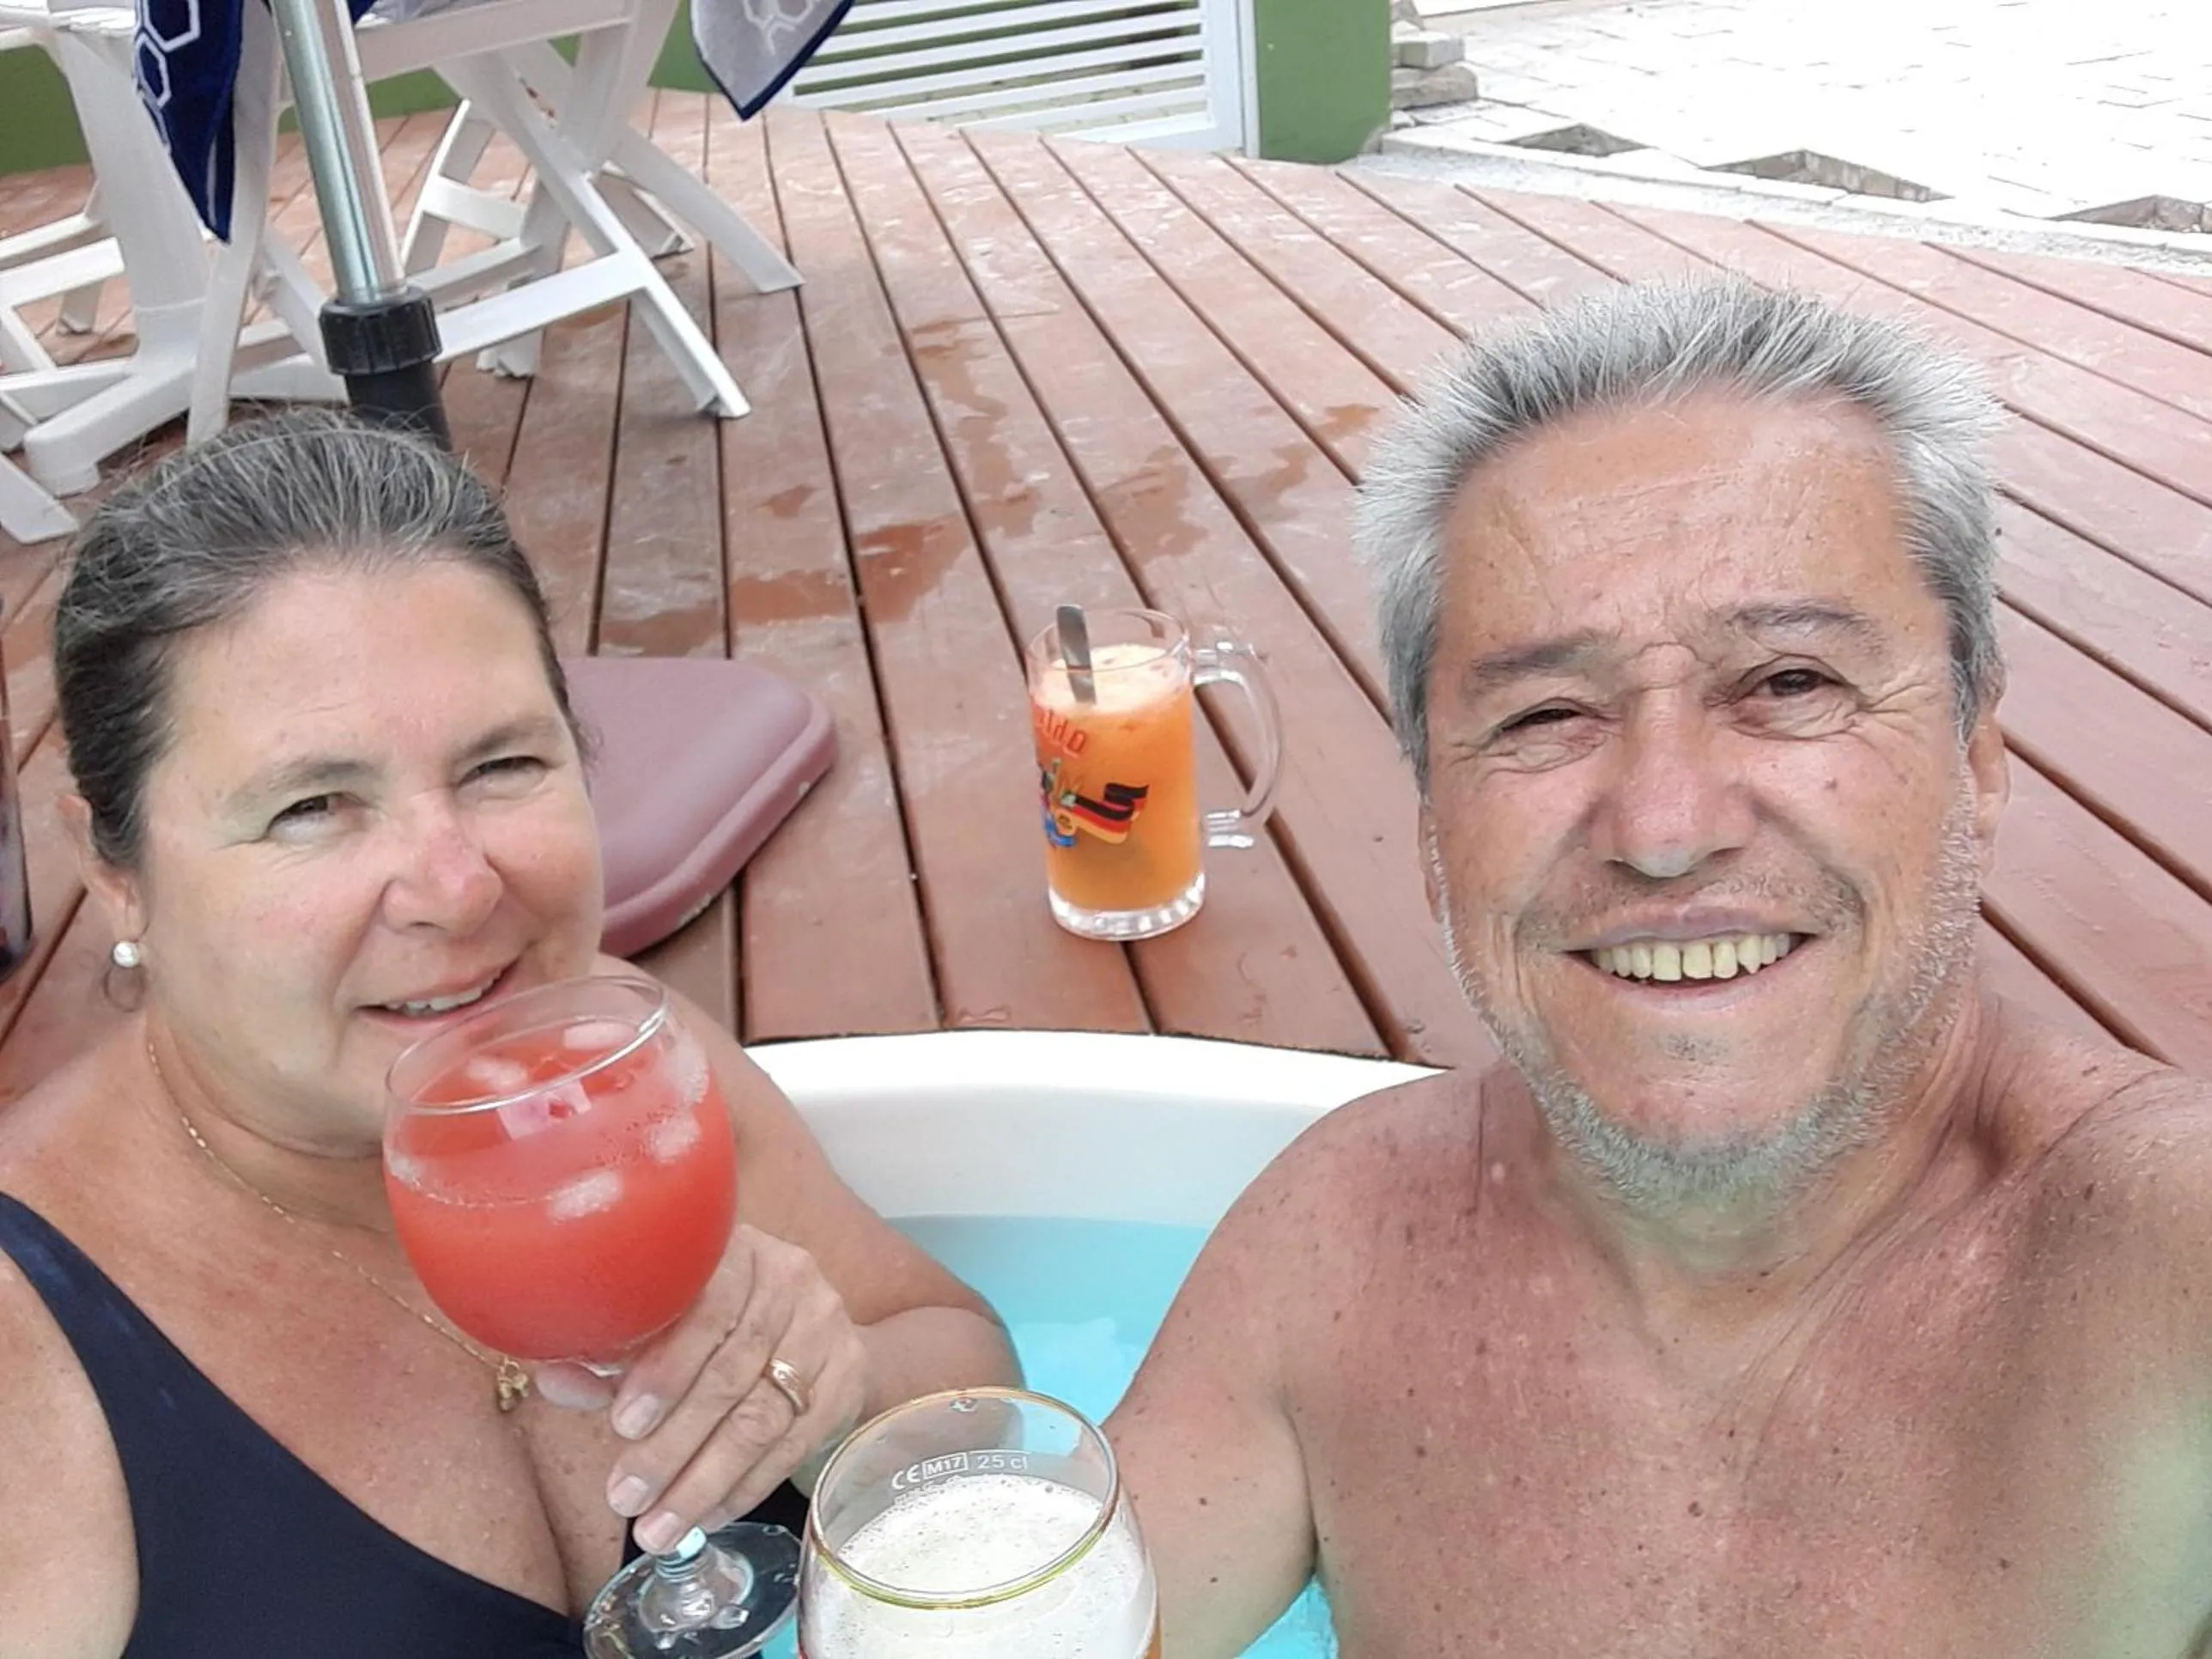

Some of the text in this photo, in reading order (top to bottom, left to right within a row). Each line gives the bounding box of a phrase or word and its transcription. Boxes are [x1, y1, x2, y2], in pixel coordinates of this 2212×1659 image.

[891, 1454, 1028, 1490] CE M17 25 cl
